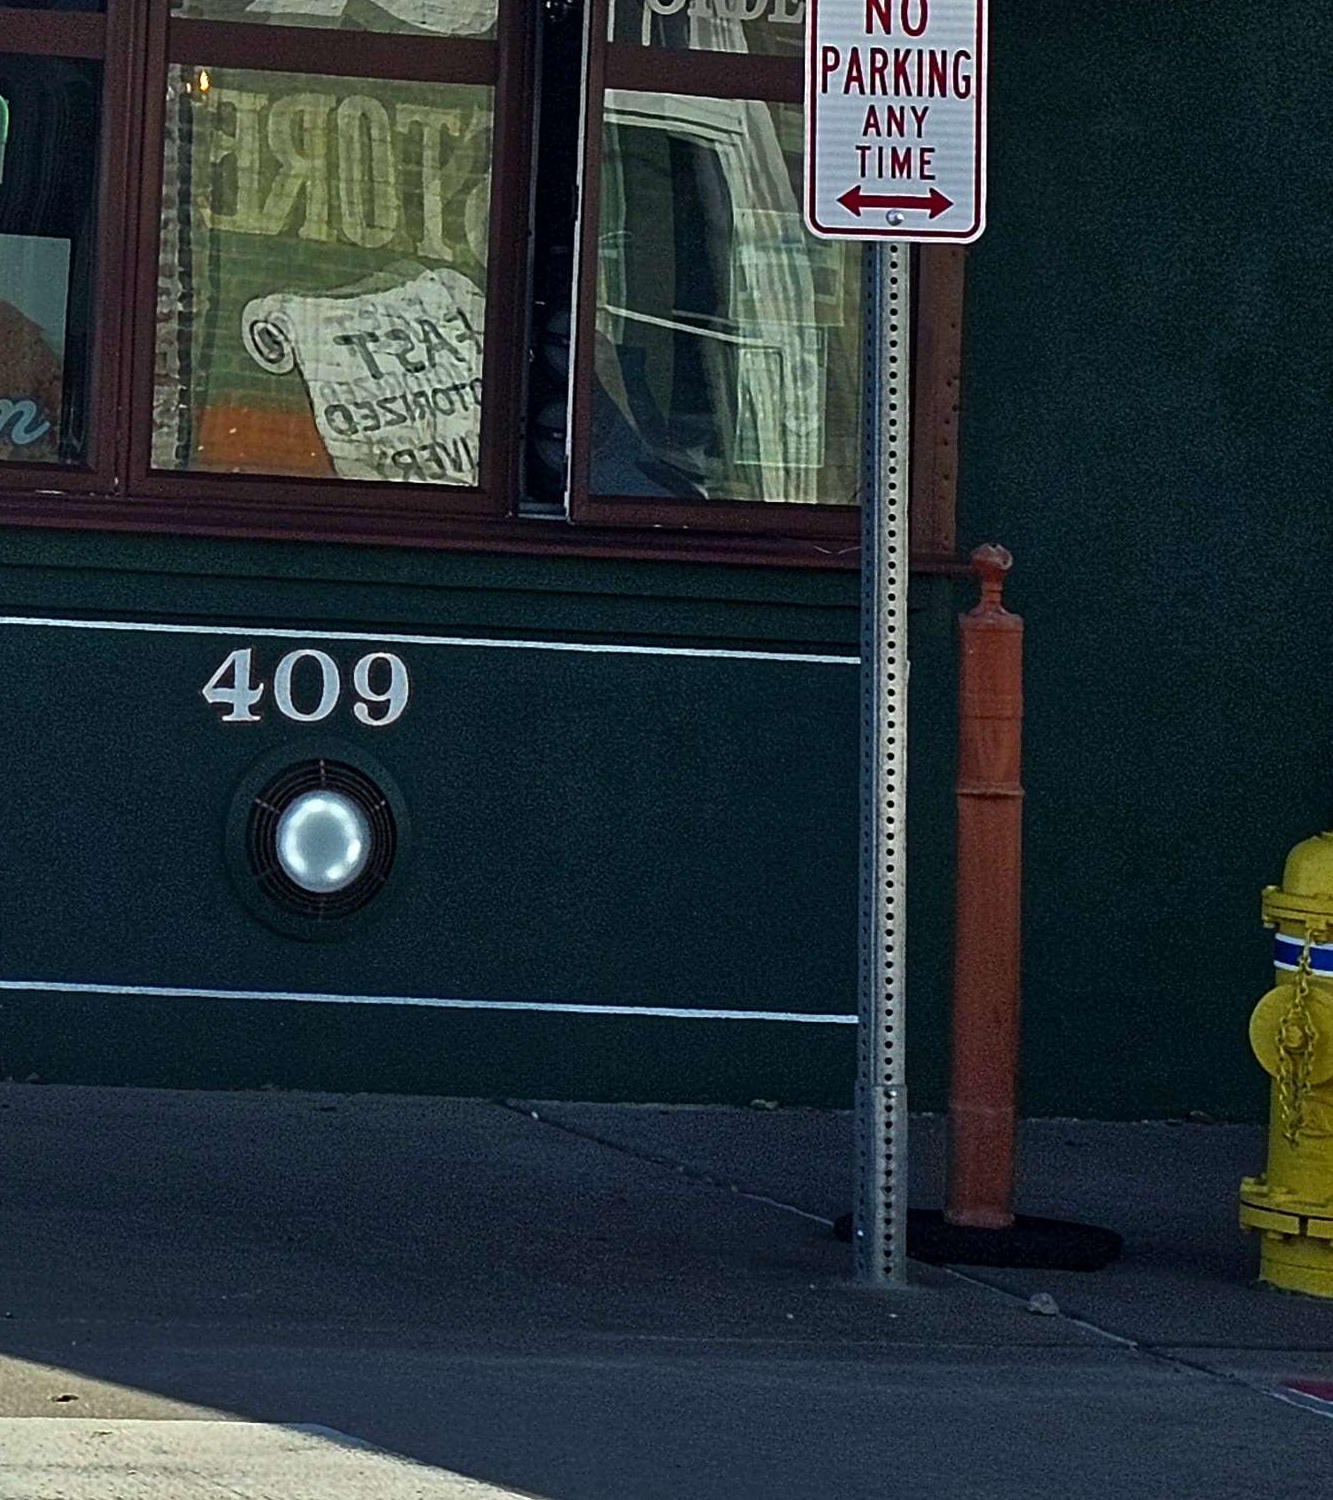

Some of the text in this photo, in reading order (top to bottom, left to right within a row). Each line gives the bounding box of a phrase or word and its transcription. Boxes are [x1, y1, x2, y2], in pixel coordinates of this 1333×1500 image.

[821, 46, 972, 100] PARKING
[862, 104, 929, 138] ANY
[855, 145, 936, 181] TIME
[201, 647, 410, 726] 409
